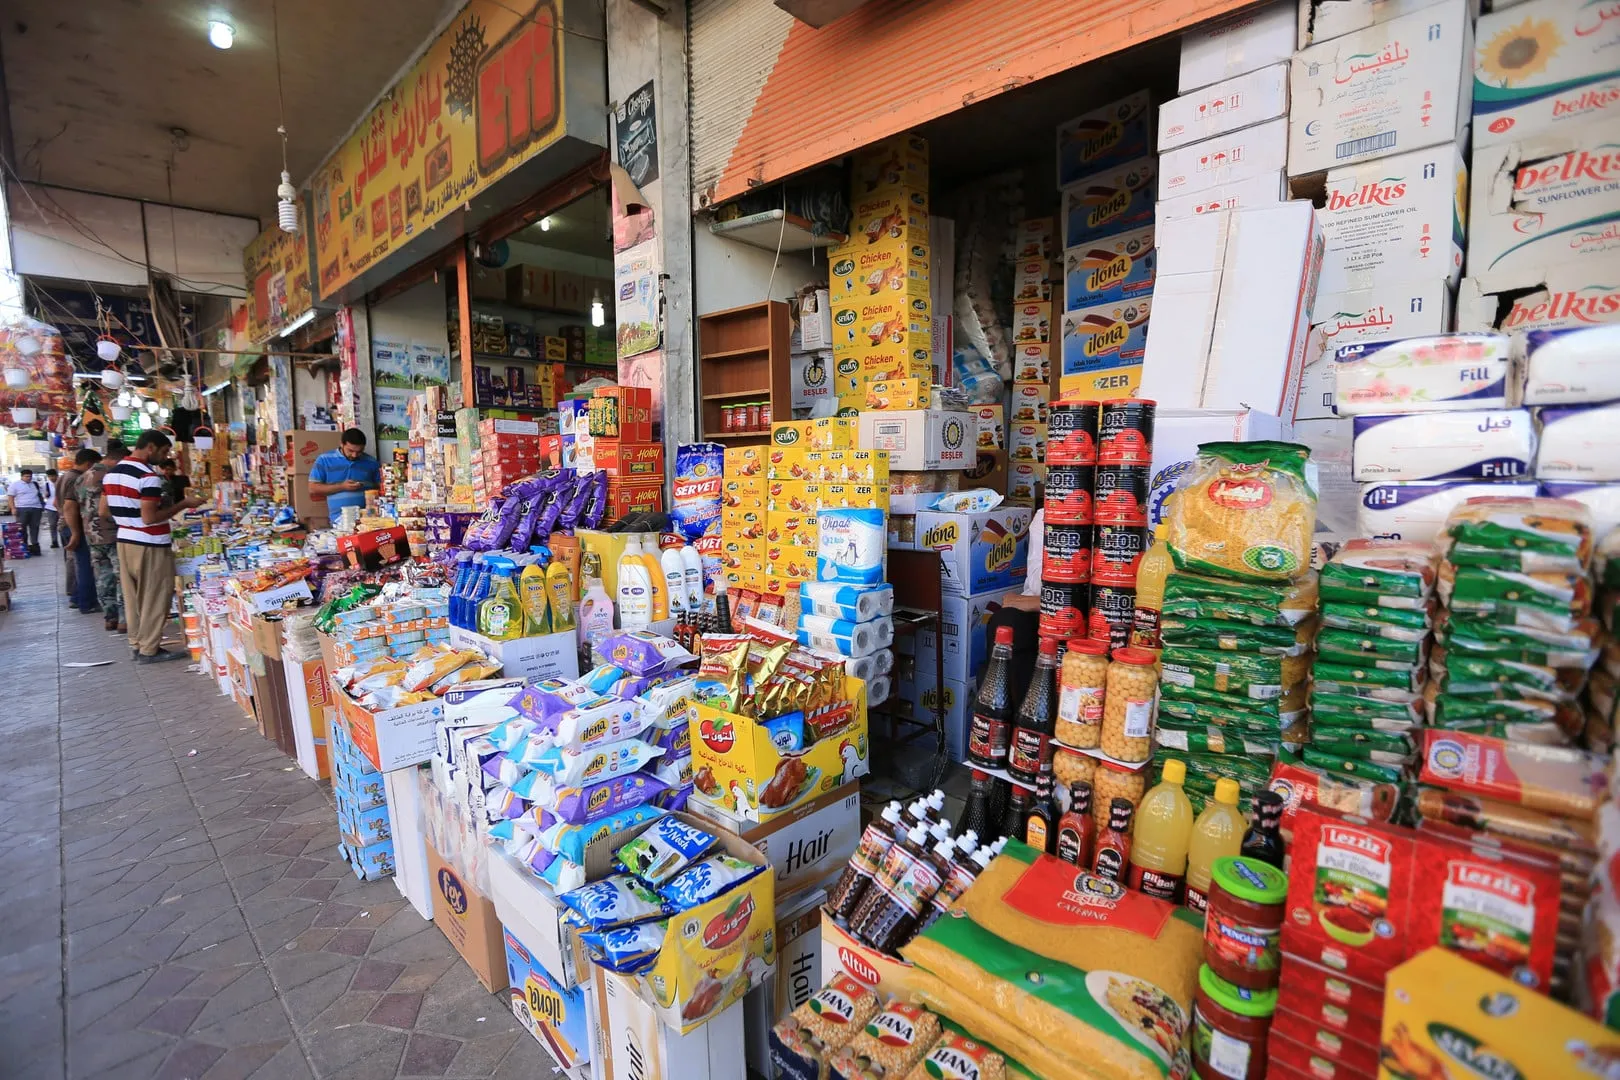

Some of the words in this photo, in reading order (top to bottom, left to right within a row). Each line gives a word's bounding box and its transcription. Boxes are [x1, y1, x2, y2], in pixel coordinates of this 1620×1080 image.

[1537, 184, 1602, 204] SUNFLOWER
[1364, 209, 1405, 221] SUNFLOWER
[860, 251, 892, 265] Chicken
[862, 304, 893, 316] Chicken
[864, 354, 894, 366] Chicken
[1460, 367, 1490, 382] Fill
[1482, 462, 1520, 477] Fill
[675, 480, 716, 497] SERVET
[925, 526, 957, 547] ilona
[1048, 532, 1081, 547] MOR
[1106, 533, 1140, 549] MOR
[582, 722, 607, 741] ilona
[786, 828, 834, 874] Hair
[1056, 901, 1109, 921] CATERING
[1220, 924, 1266, 947] PENGUEN
[841, 950, 878, 984] Altun
[817, 989, 854, 1017] HANA
[874, 1012, 913, 1041] HANA
[934, 1049, 980, 1080] HANA
